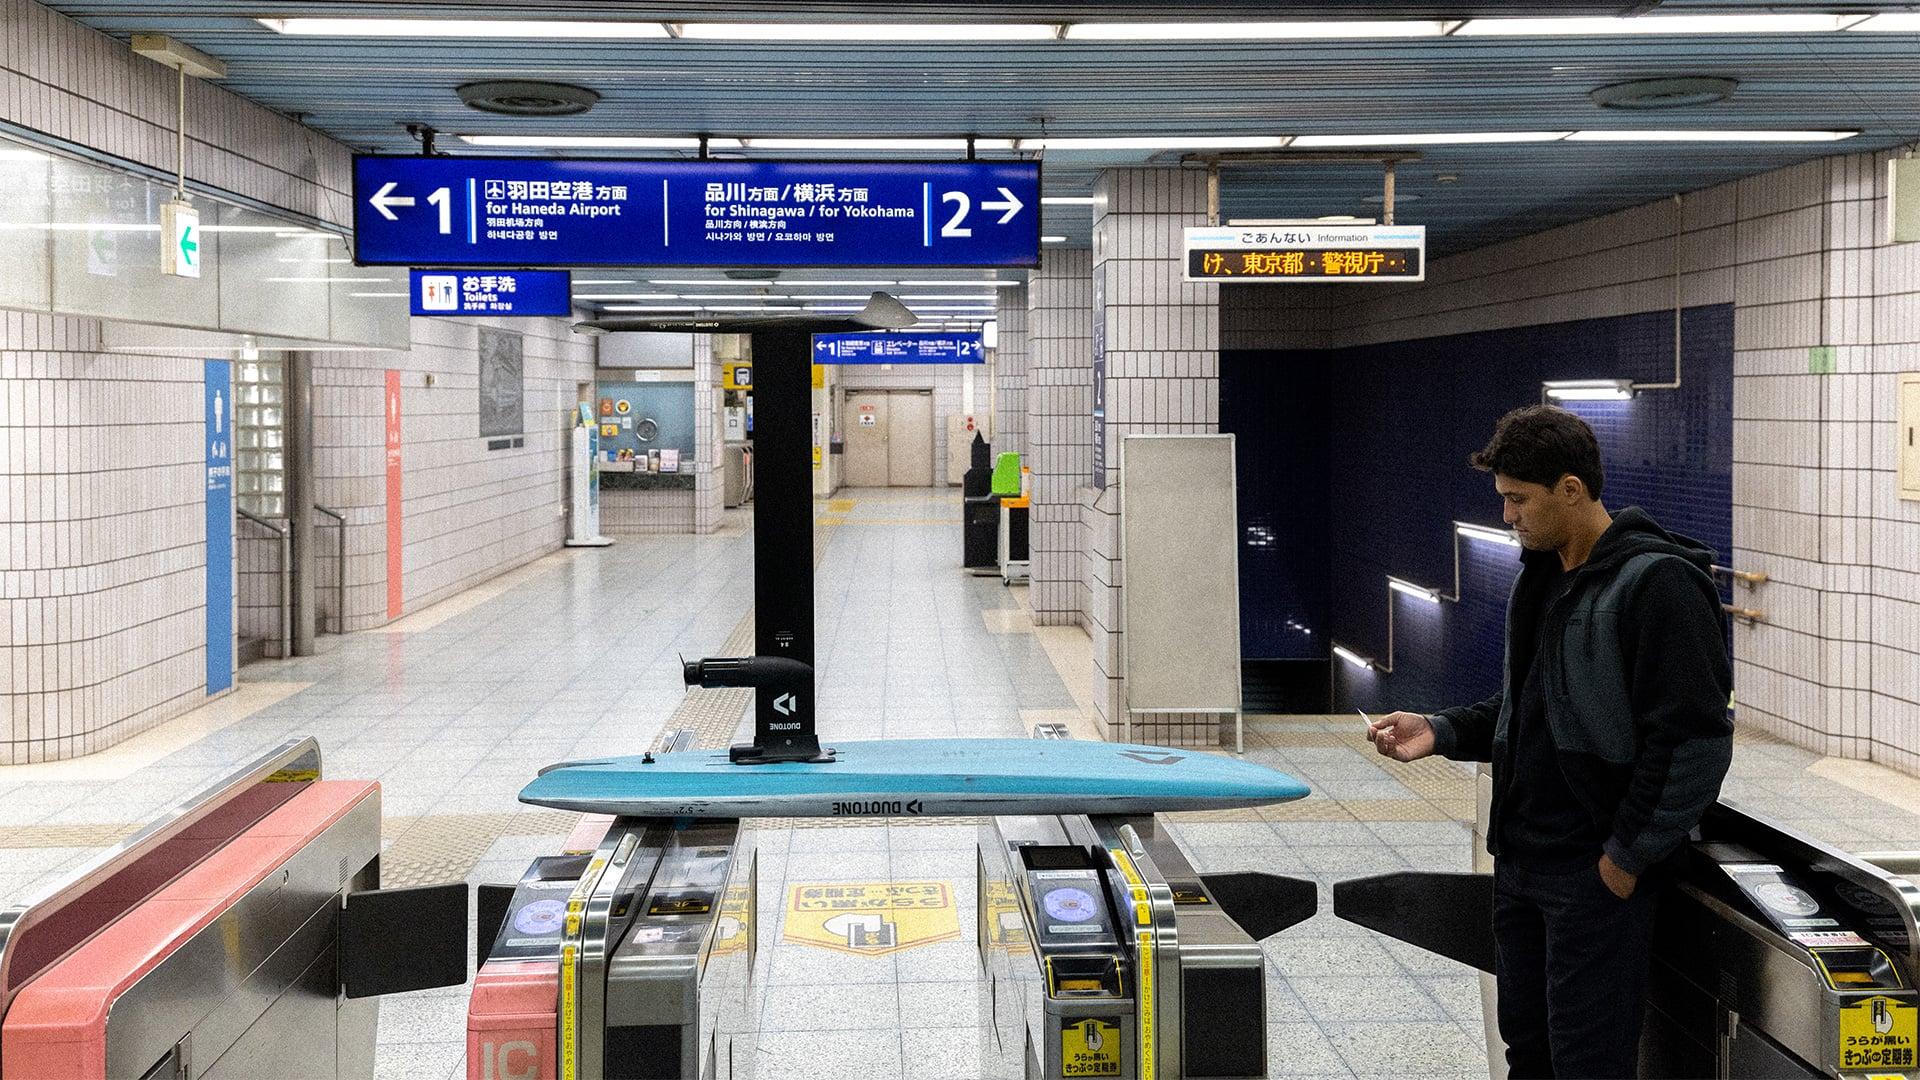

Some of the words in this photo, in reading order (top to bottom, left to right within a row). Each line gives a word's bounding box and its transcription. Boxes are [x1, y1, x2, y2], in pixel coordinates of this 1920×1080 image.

[506, 180, 628, 201] 羽田空港方面
[426, 186, 452, 235] 1
[486, 201, 508, 215] for
[511, 202, 565, 216] Haneda
[569, 202, 621, 218] Airport
[704, 204, 726, 217] for
[729, 204, 806, 220] Shinagawa
[819, 204, 841, 217] for
[843, 204, 915, 218] Yokohama
[940, 190, 972, 238] 2
[705, 232, 743, 242] 시나가와
[746, 232, 765, 242] 방면
[816, 231, 835, 242] 방면
[1241, 232, 1311, 244] ごあんない
[1317, 233, 1369, 242] Information
[1203, 251, 1406, 275] け、東京都・警視庁・
[462, 276, 517, 293] お手洗
[463, 292, 499, 302] Toilets
[828, 341, 835, 356] 1
[960, 341, 971, 356] 2
[769, 722, 801, 731] DUOTONE
[832, 800, 902, 815] DUOTONE
[483, 1040, 538, 1080] IC
